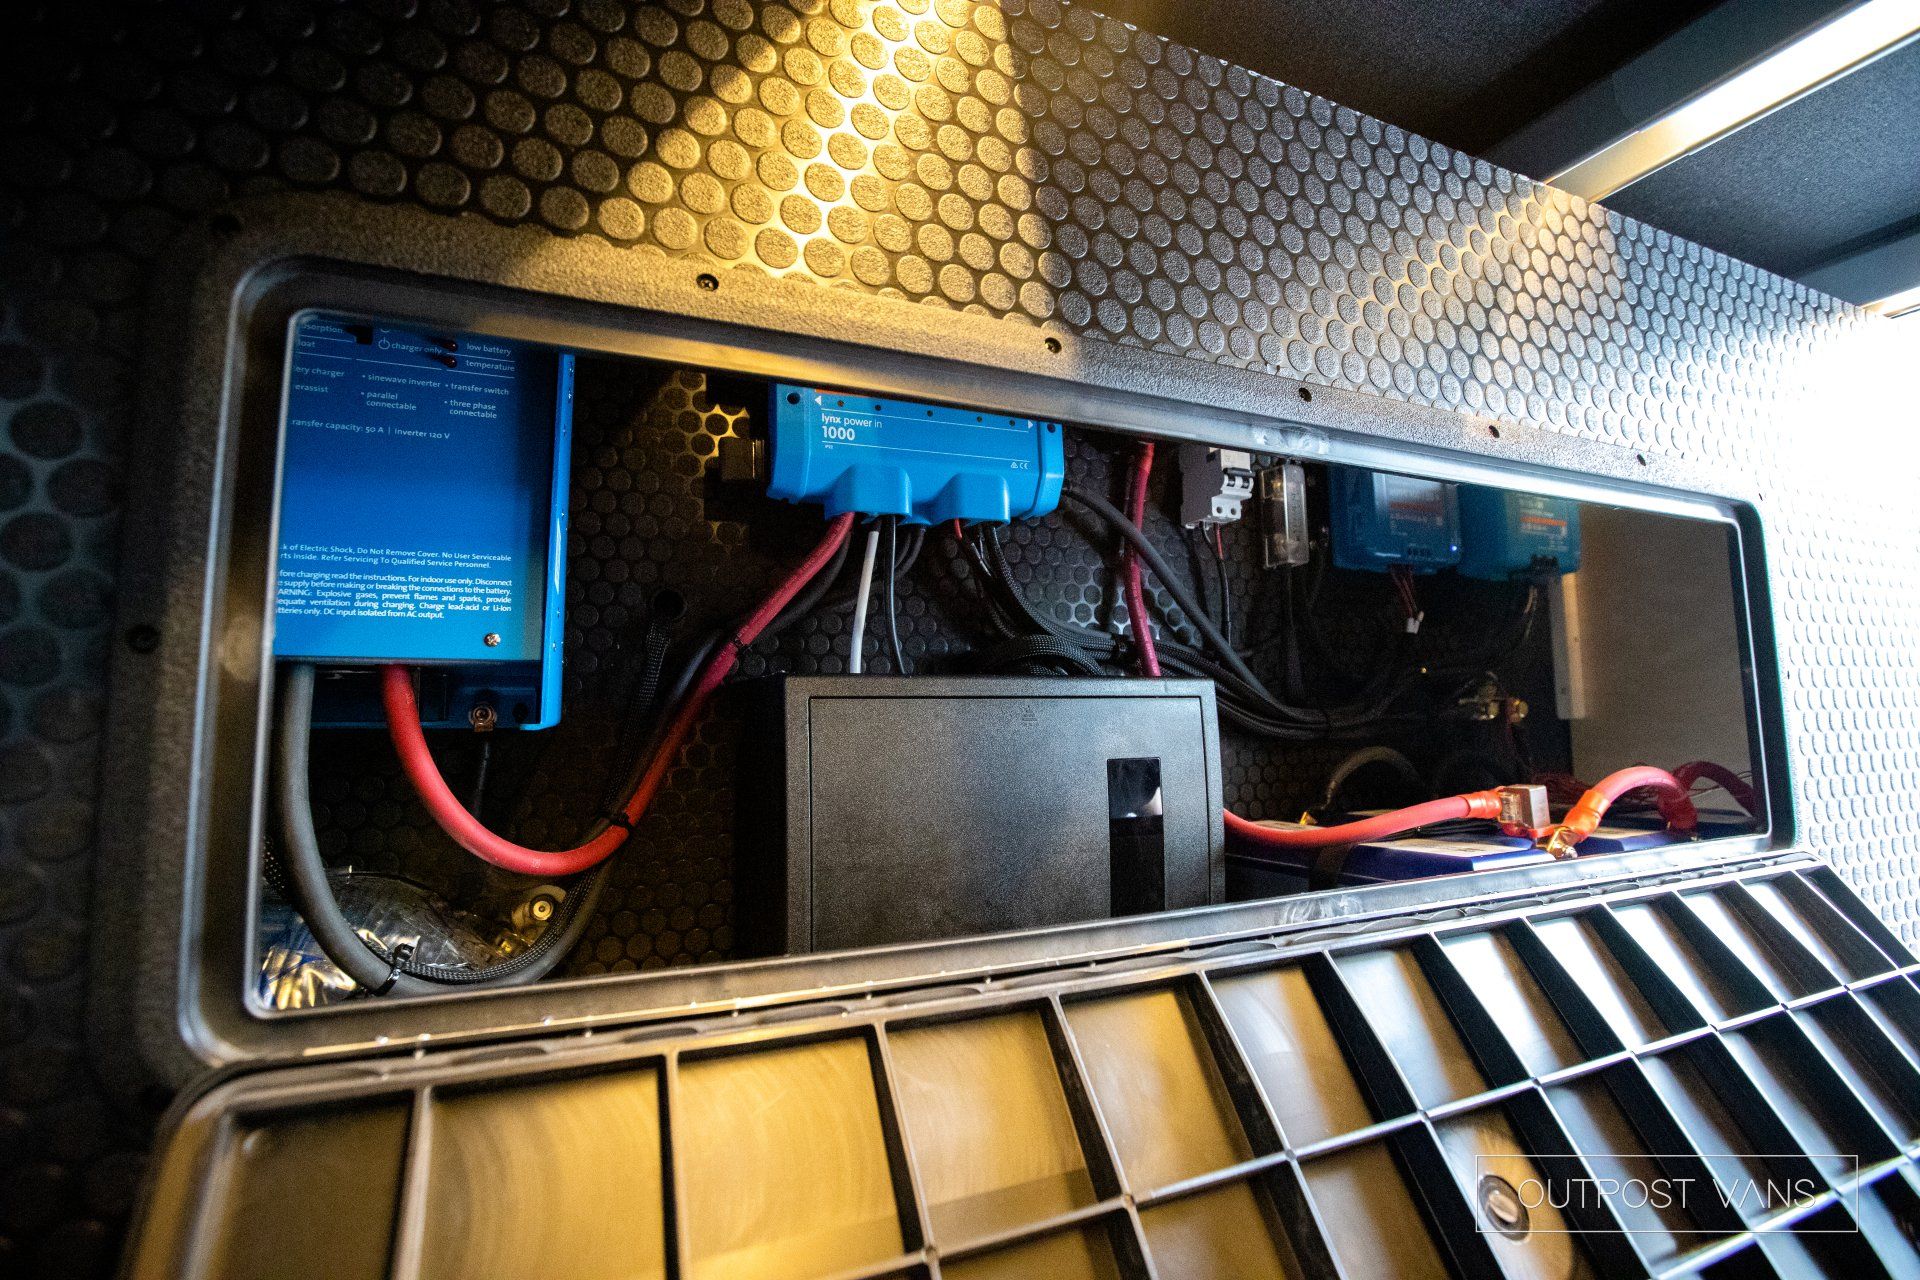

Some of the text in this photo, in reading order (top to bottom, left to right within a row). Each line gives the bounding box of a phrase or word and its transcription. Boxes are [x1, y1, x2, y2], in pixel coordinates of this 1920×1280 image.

[303, 324, 343, 334] sorption
[391, 343, 443, 355] charger only
[466, 343, 512, 357] low battery
[294, 366, 345, 379] ery charger
[465, 359, 515, 372] temperature
[368, 373, 441, 388] sinewave inverter
[366, 390, 398, 400] parallel
[451, 383, 510, 396] transfer switch
[366, 399, 417, 411] connectable
[450, 399, 496, 412] three phase
[449, 408, 497, 419] connectable
[821, 412, 882, 429] lynx power in
[325, 422, 364, 433] capacity:
[365, 426, 376, 434] 50
[394, 428, 427, 438] Inverter
[429, 431, 443, 440] 120
[444, 432, 450, 440] V
[821, 425, 856, 441] 1000
[300, 544, 328, 552] Electric
[330, 545, 355, 555] Shock,
[357, 547, 368, 555] Do
[385, 548, 416, 557] Remove
[417, 550, 440, 558] Cover.
[441, 551, 453, 559] No
[453, 552, 471, 560] User
[472, 553, 512, 562] Serviceable
[343, 555, 379, 565] Servicing
[391, 557, 425, 566] Qualified
[427, 559, 453, 567] Service
[454, 560, 491, 569] Personnel.
[296, 570, 331, 581] charging
[331, 572, 349, 580] read
[349, 572, 362, 580] the
[363, 573, 407, 582] instructions.
[408, 575, 420, 583] For
[420, 575, 444, 584] indoor
[457, 577, 474, 587] only.
[475, 578, 512, 587] Disconnect
[283, 580, 310, 589] supply
[310, 580, 335, 588] before
[336, 582, 366, 591] making
[375, 583, 408, 593] breaking
[408, 584, 420, 592] the
[421, 585, 464, 593] connections
[464, 586, 473, 594] to
[473, 586, 485, 594] the
[485, 586, 512, 597] battery.
[316, 589, 352, 598] Explosive
[355, 591, 378, 600] gases,
[381, 592, 410, 601] prevent
[414, 592, 438, 601] flames
[441, 594, 456, 602] and
[459, 594, 483, 603] sparks,
[486, 595, 512, 604] provide
[309, 598, 351, 607] ventilation
[354, 600, 379, 609] during
[382, 600, 416, 611] charging.
[419, 602, 445, 612] Charge
[447, 602, 480, 611] lead-acid
[276, 606, 444, 620] tteries only. DC input isolated from AC output.
